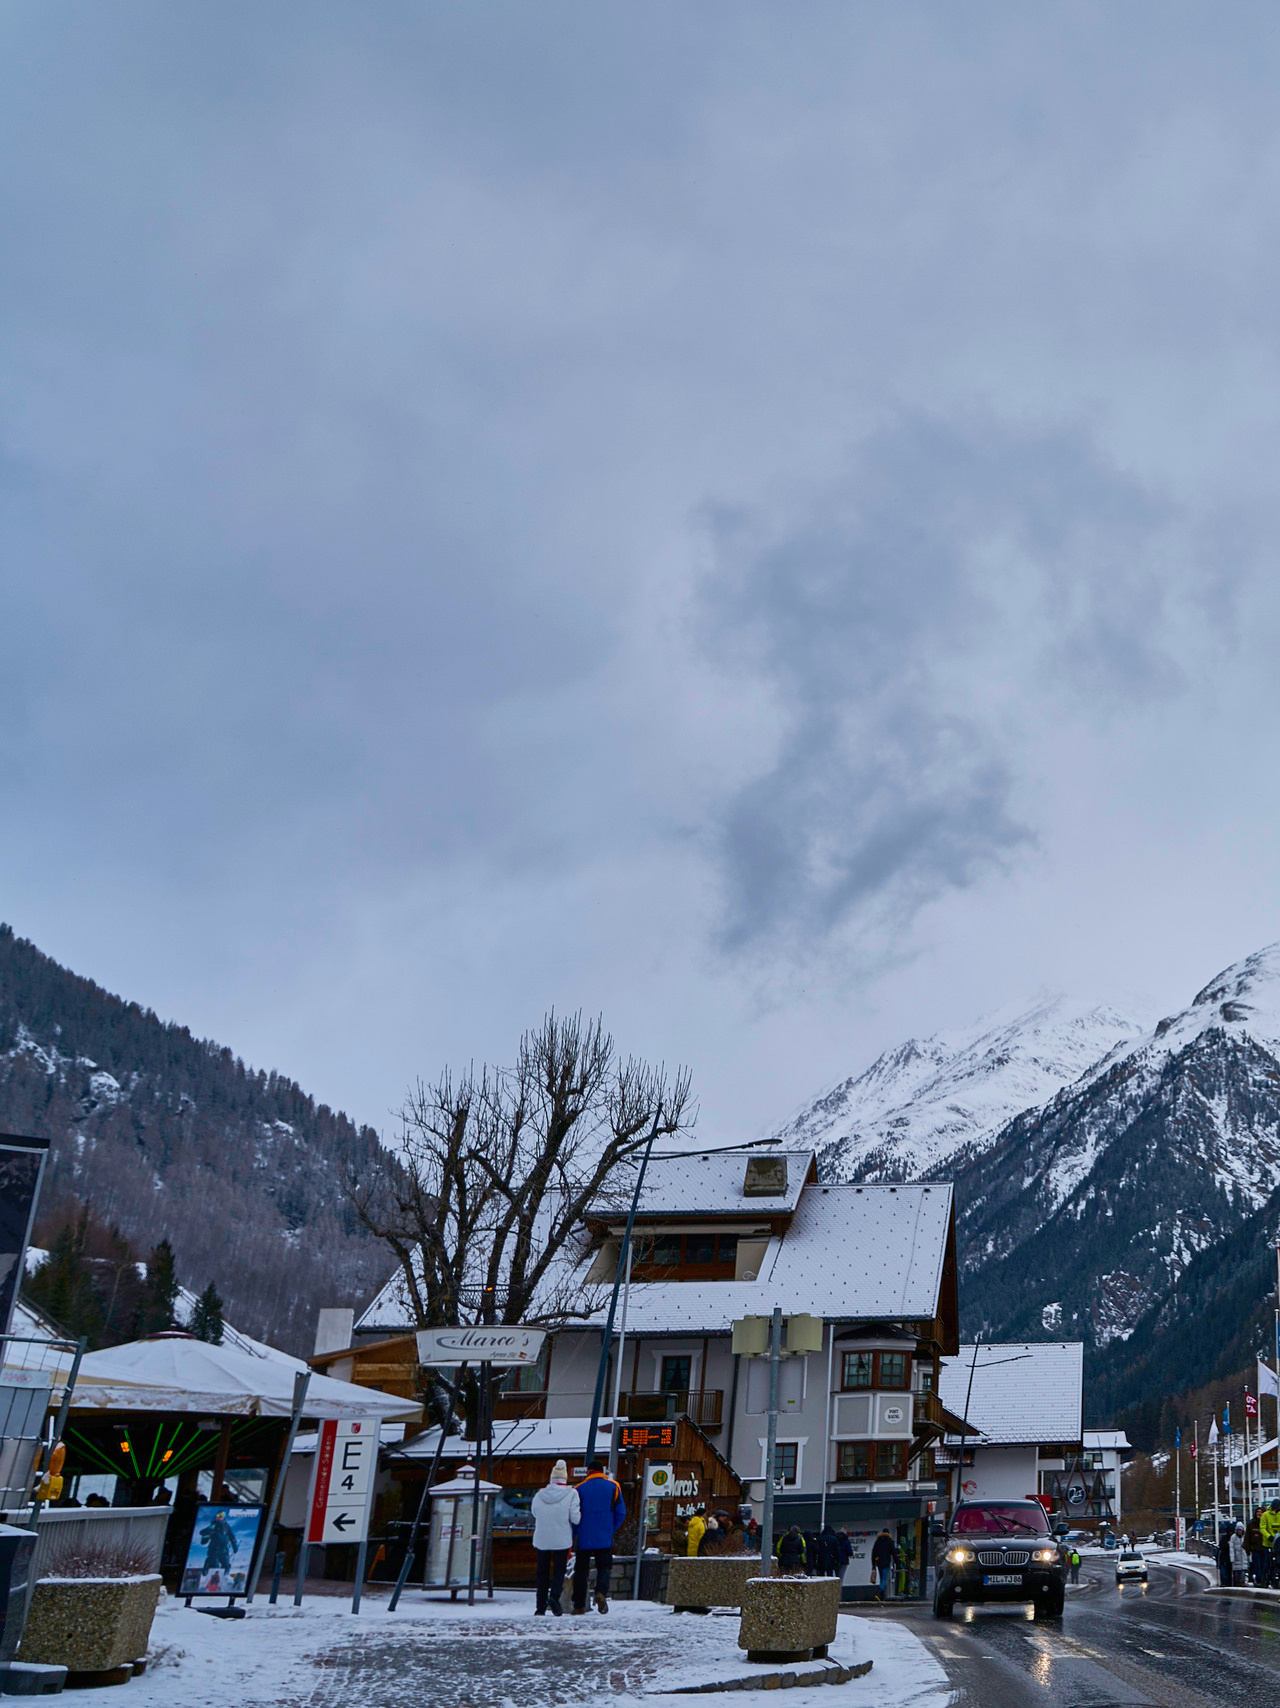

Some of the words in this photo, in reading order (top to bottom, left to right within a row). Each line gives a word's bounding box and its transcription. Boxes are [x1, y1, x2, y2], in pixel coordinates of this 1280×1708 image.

[449, 1330, 529, 1347] Marco's
[342, 1441, 363, 1470] E
[341, 1474, 354, 1490] 4
